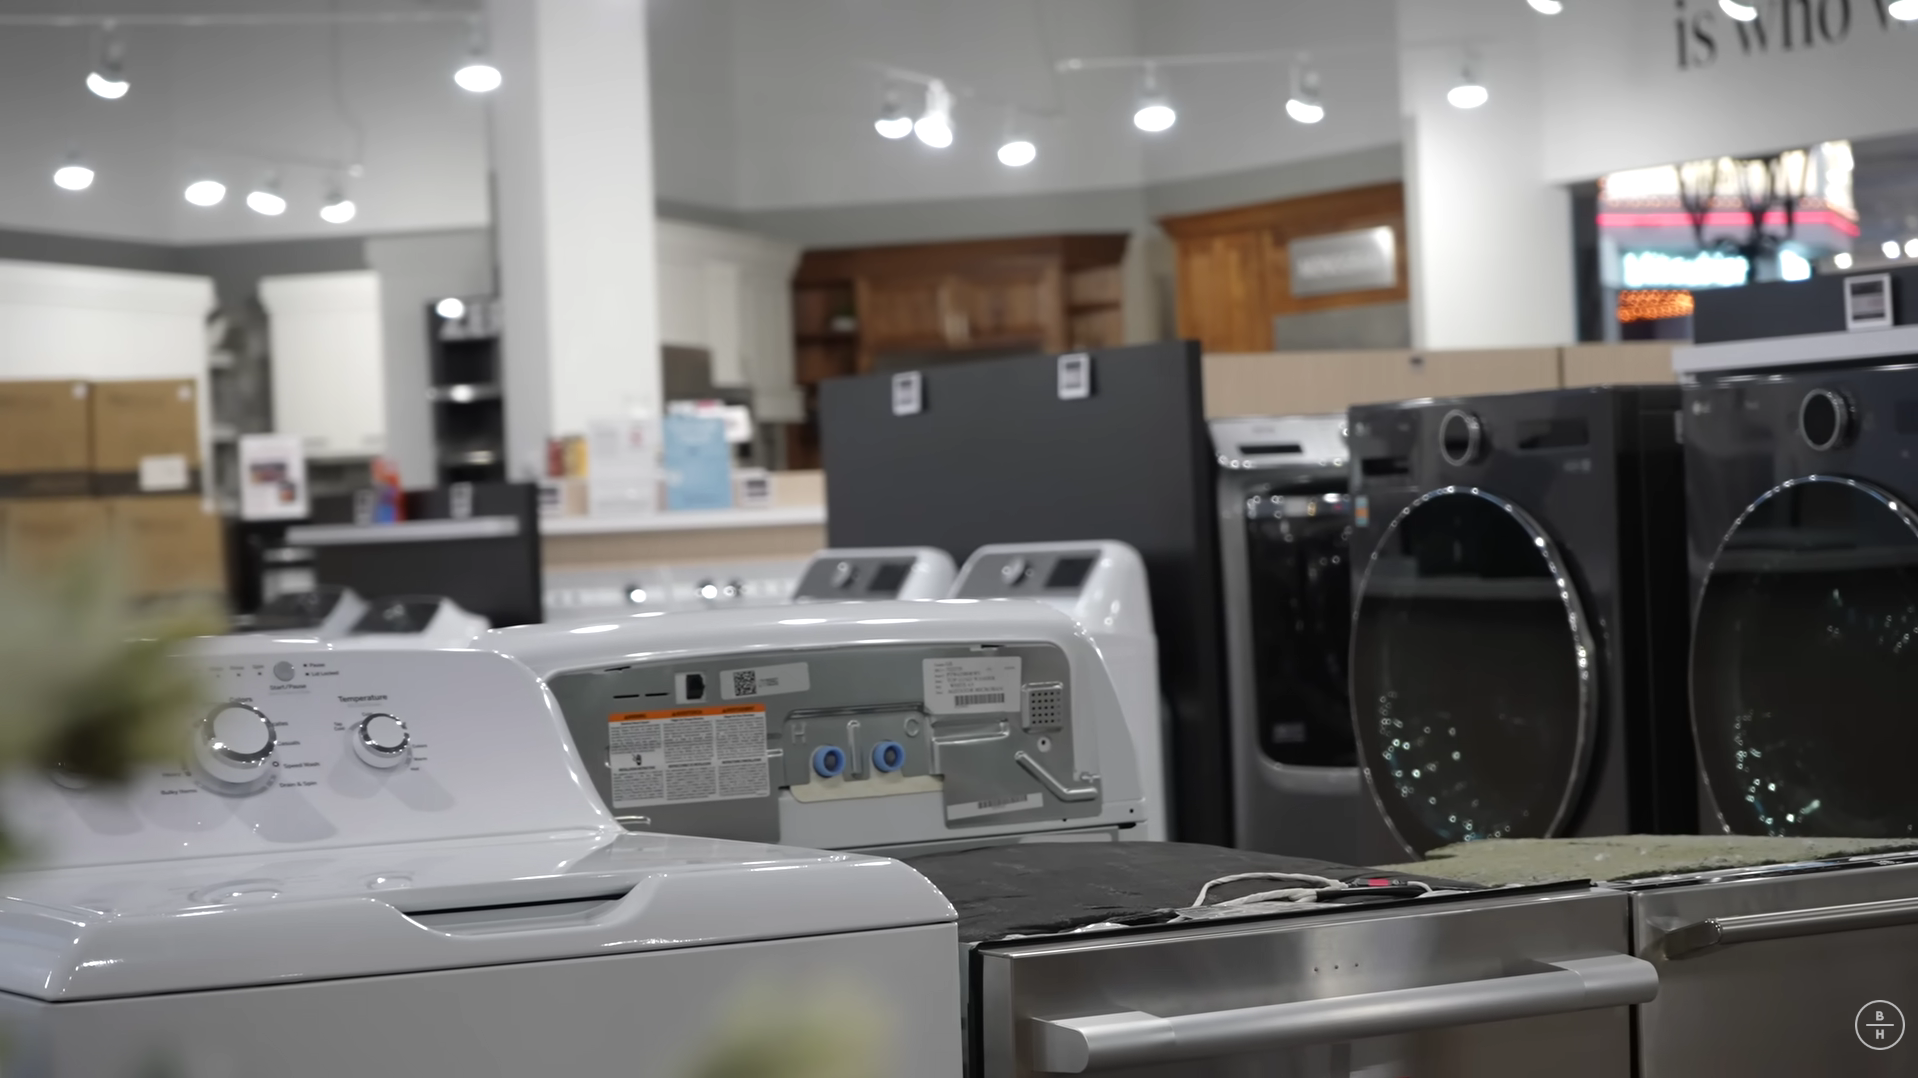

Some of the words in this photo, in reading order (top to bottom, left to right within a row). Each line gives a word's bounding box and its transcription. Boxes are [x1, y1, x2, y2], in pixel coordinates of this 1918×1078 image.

[1675, 0, 1718, 70] is
[269, 683, 307, 691] Start/Pause
[337, 694, 388, 703] Temperature
[791, 722, 807, 744] H
